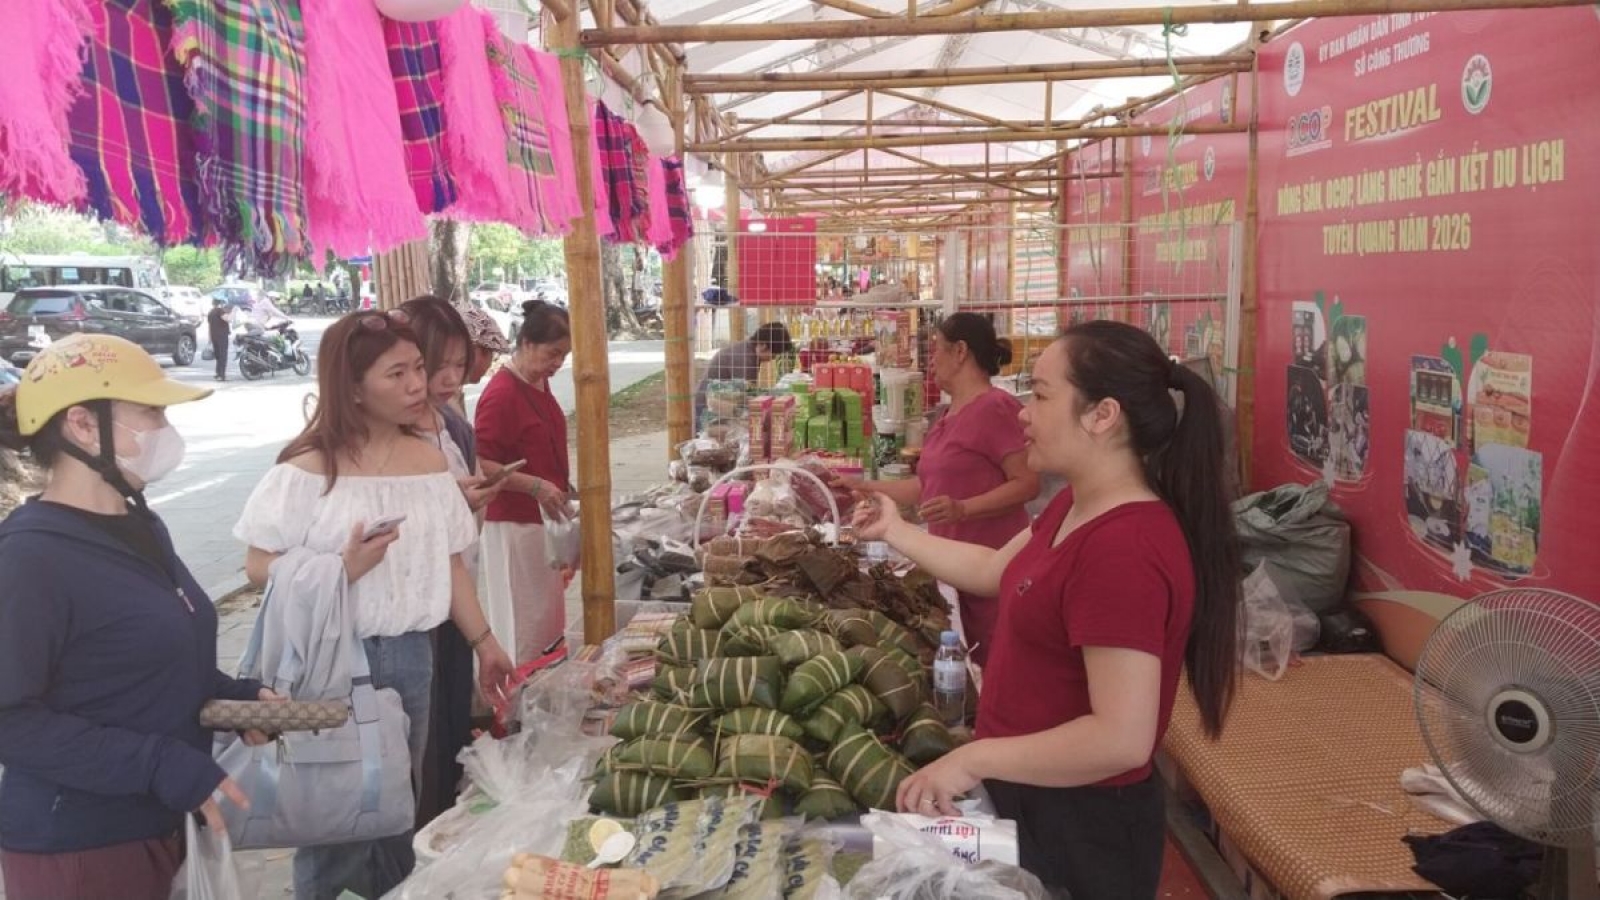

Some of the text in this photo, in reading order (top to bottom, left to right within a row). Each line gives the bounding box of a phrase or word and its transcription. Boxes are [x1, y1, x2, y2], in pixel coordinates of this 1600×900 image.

[1329, 36, 1345, 58] BAN
[1368, 48, 1391, 72] CÔNG
[1344, 83, 1441, 141] FESTIVAL
[1278, 183, 1301, 215] NÔNG
[1326, 175, 1354, 209] OCOP,
[1356, 167, 1385, 205] LÀNG
[1388, 152, 1422, 202] NGHỀ
[1427, 148, 1455, 197] GẮN
[1460, 140, 1489, 193] KẾT
[1493, 147, 1517, 188] DU
[1522, 139, 1564, 192] LỊCH
[1323, 212, 1471, 256] TUYÊN QUANG NĂM 2026
